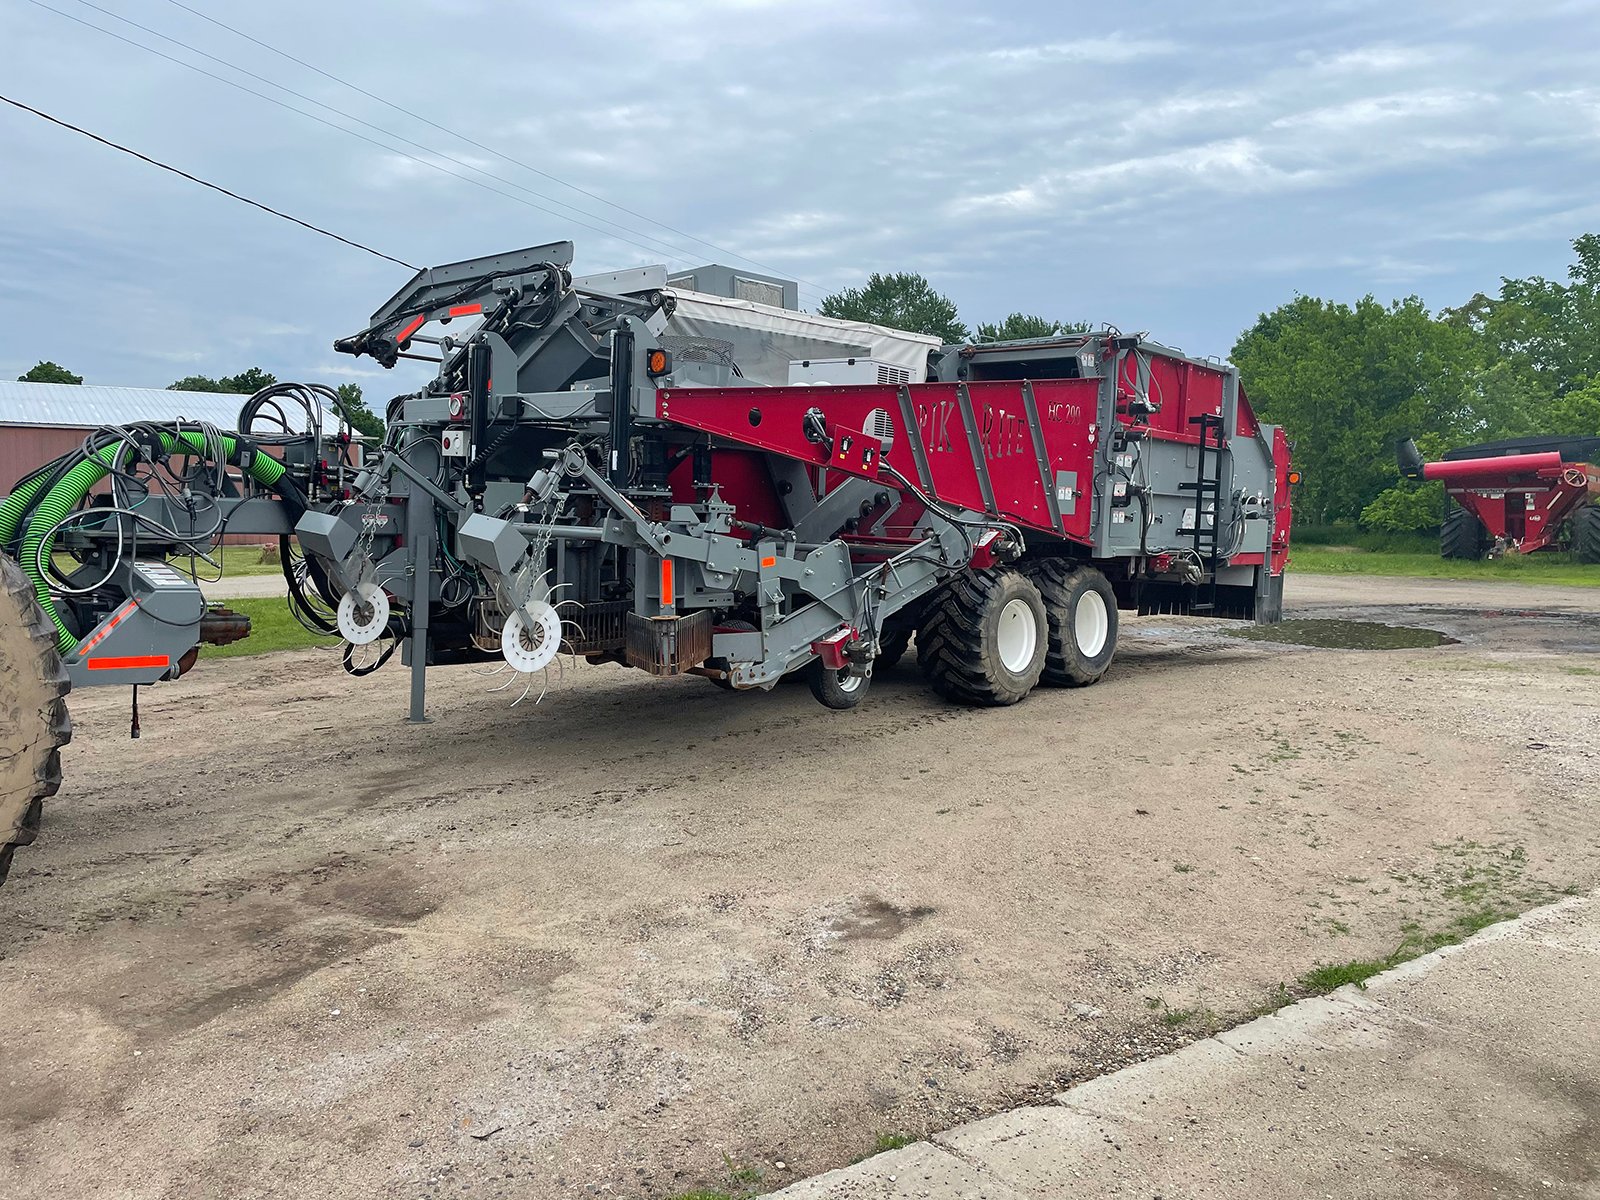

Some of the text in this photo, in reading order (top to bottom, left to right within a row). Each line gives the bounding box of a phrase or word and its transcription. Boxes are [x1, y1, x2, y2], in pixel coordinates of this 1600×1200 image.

[918, 400, 1025, 460] PIK RITE
[1048, 401, 1063, 423] HC
